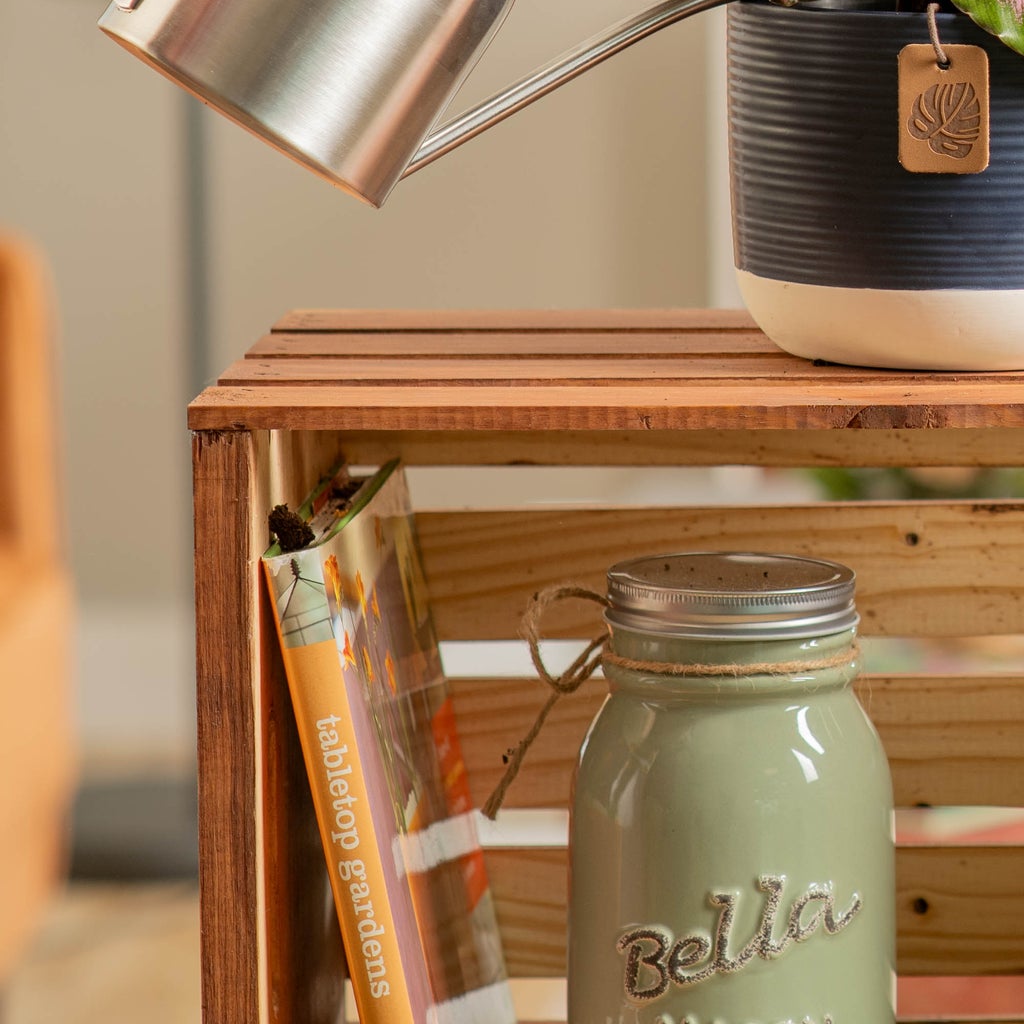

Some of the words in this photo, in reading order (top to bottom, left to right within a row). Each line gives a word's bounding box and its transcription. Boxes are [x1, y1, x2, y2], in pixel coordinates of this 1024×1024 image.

[316, 714, 360, 850] tabletop
[338, 859, 391, 999] gardens
[616, 874, 863, 1001] Bella
